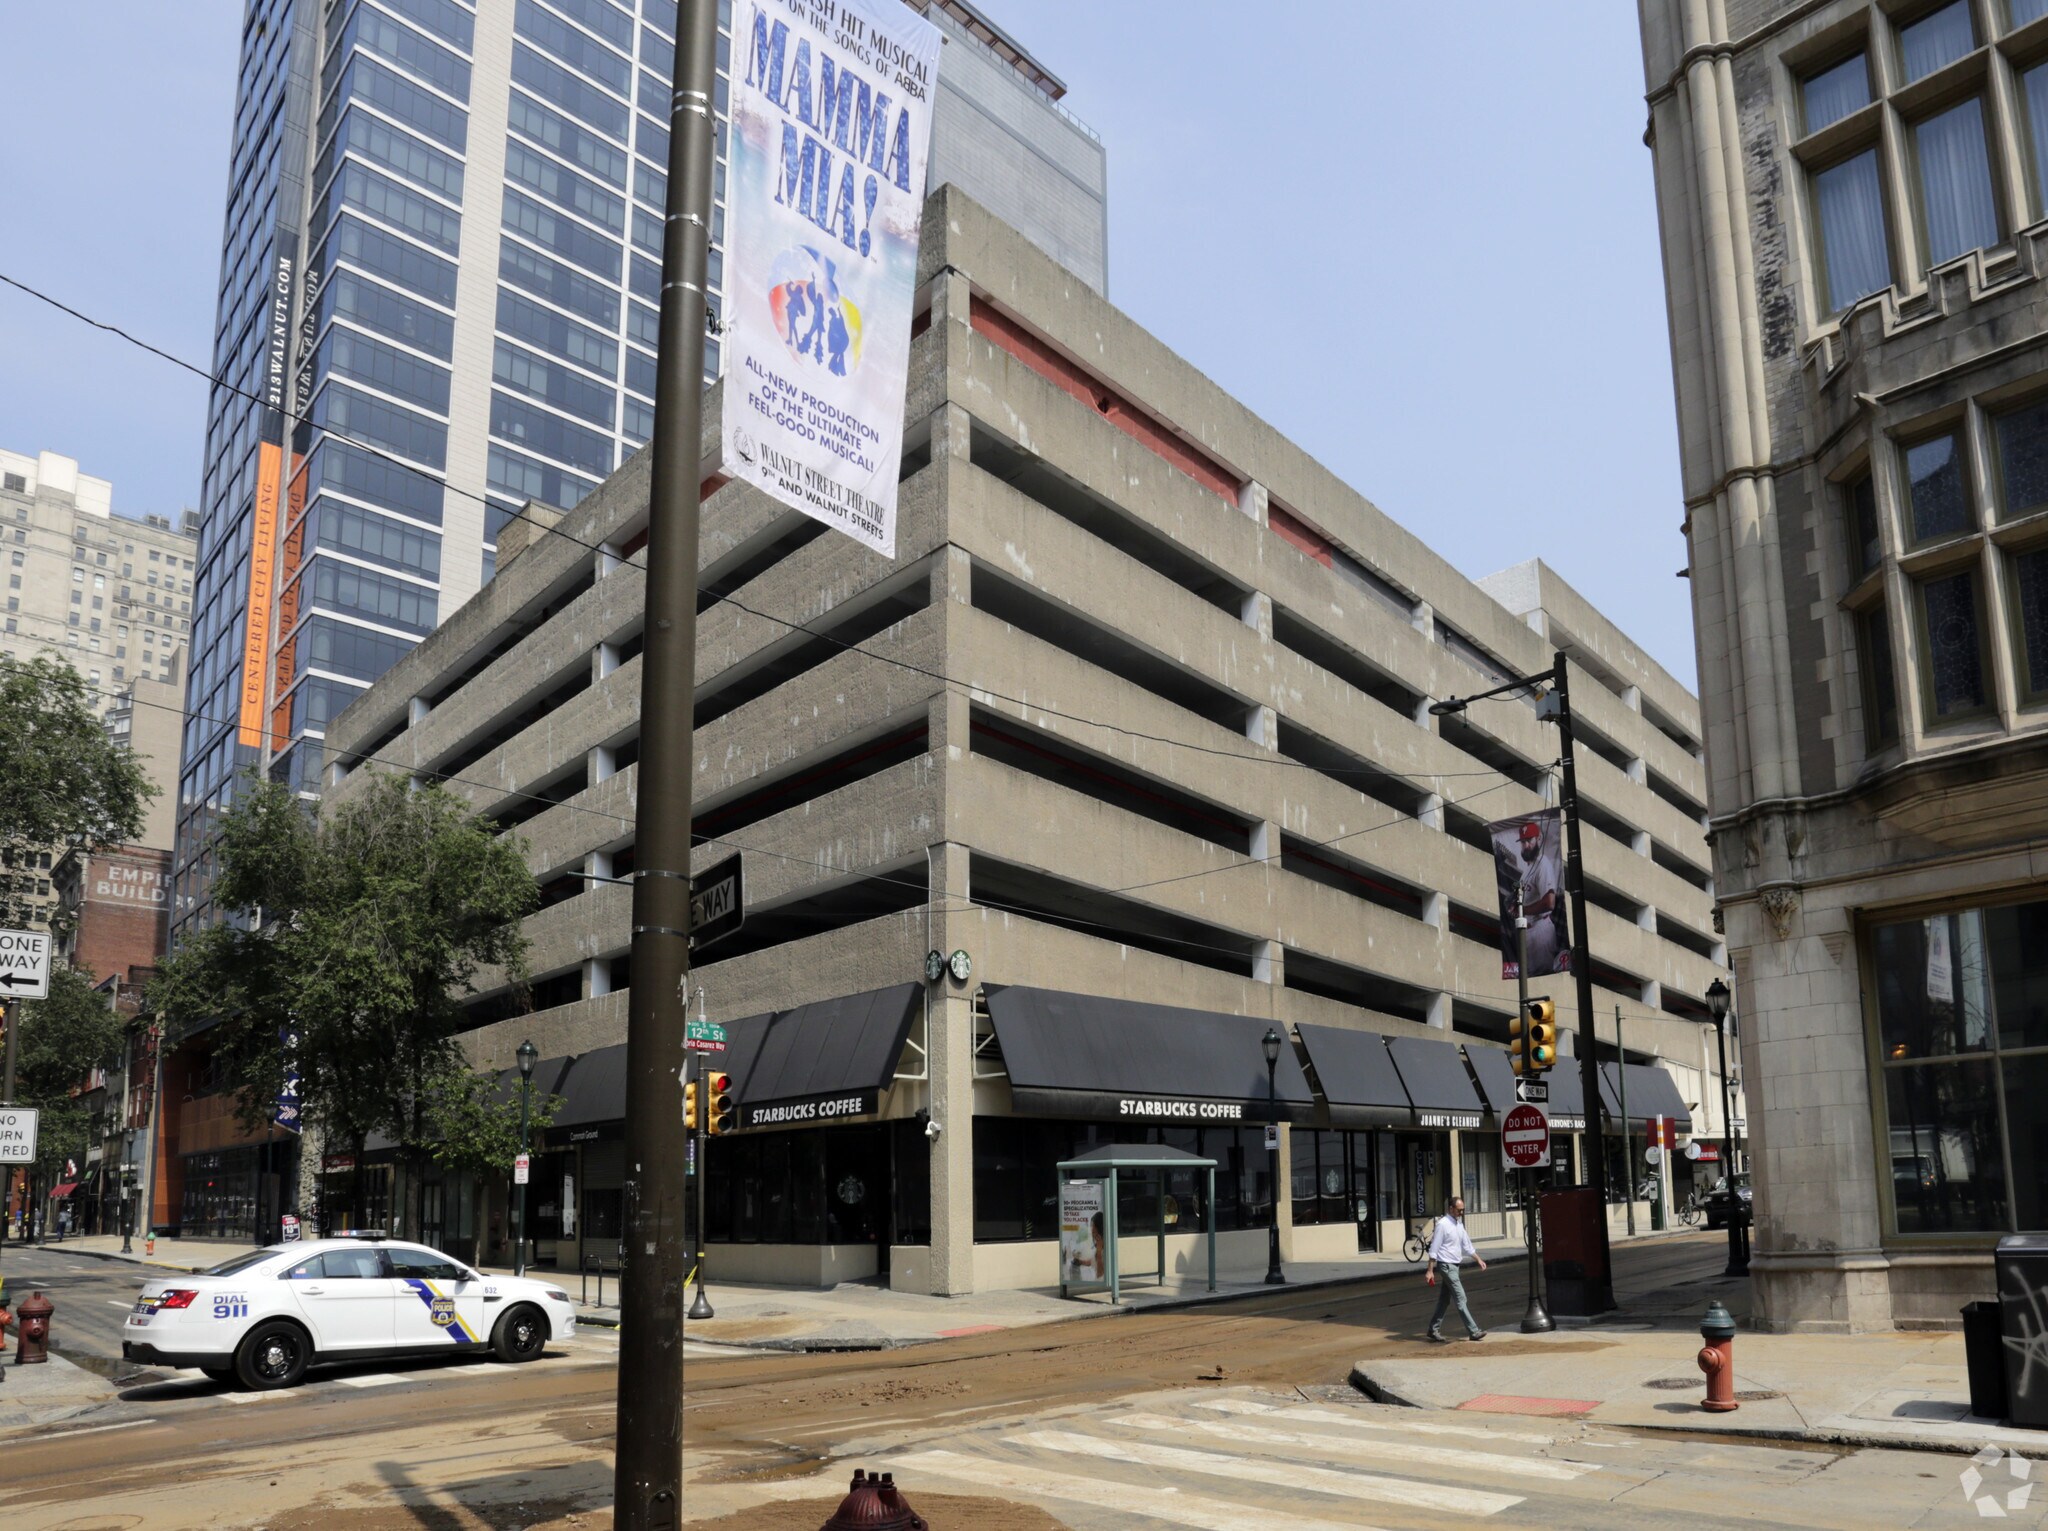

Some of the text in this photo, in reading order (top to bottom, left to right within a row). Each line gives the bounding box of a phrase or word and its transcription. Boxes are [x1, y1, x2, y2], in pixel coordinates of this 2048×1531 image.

[809, 10, 830, 38] THE
[833, 29, 871, 66] SONGS
[876, 57, 891, 78] OF
[894, 71, 926, 103] ABBA
[841, 8, 866, 40] HIT
[870, 28, 930, 86] MUSICAL
[745, 3, 912, 195] MAMMA
[774, 118, 878, 259] MIA!
[745, 354, 879, 444] ALL-NEW PRODUCTION
[762, 385, 862, 450] OF THE ULTIMATE
[748, 392, 874, 473] FEEL-GOOD MUSICAL!
[761, 443, 886, 526] WALNUT STREET THEATRE
[778, 477, 803, 496] AND
[806, 490, 849, 519] WALNUT
[851, 512, 884, 541] STREETS
[247, 482, 273, 704] CENTERED CITY LIVING
[703, 880, 731, 921] WAY
[0, 936, 42, 953] ONE
[0, 953, 41, 970] WAY
[692, 1027, 724, 1041] 12th St
[715, 1042, 726, 1052] Way
[1526, 1086, 1545, 1096] ONE WAY
[752, 1097, 862, 1124] STARBUCKS COFFEE
[1120, 1099, 1242, 1119] STARBUCKS COFFEE
[1451, 1115, 1480, 1128] CLEANERS
[1508, 1115, 1541, 1128] DO NOT
[2, 1145, 29, 1156] RED
[1512, 1143, 1539, 1155] ENTER
[1415, 1151, 1425, 1214] CLEANERS
[213, 1295, 249, 1305] DIAL
[213, 1304, 248, 1319] 911
[434, 1303, 454, 1313] POLICE
